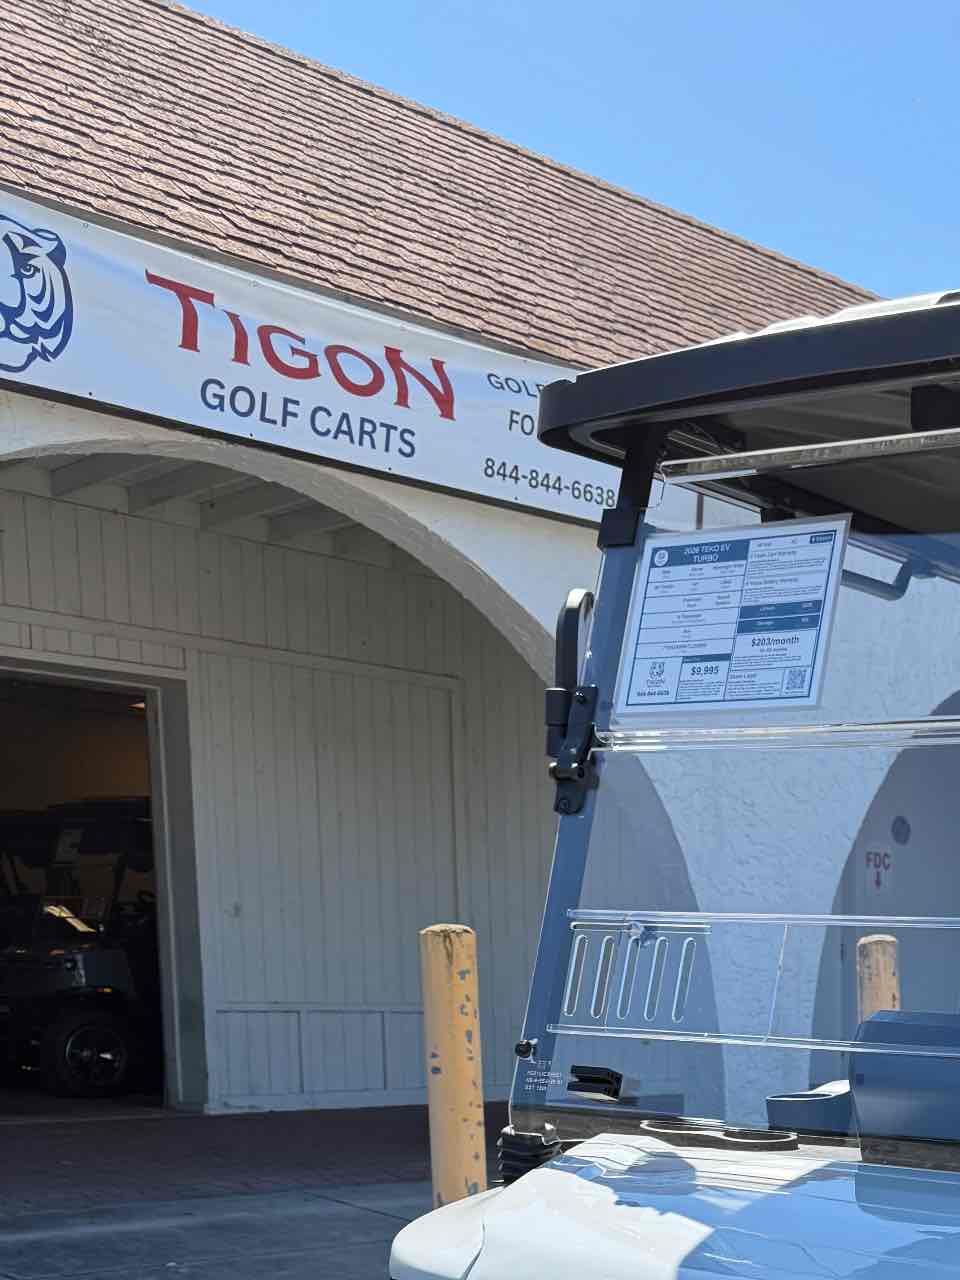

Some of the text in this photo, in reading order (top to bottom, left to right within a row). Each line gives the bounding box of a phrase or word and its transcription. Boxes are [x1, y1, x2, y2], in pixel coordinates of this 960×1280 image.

[145, 269, 456, 421] TIGON
[200, 378, 417, 458] GOLF CARTS
[484, 457, 616, 508] 844-844-6638
[866, 851, 892, 871] FDC
